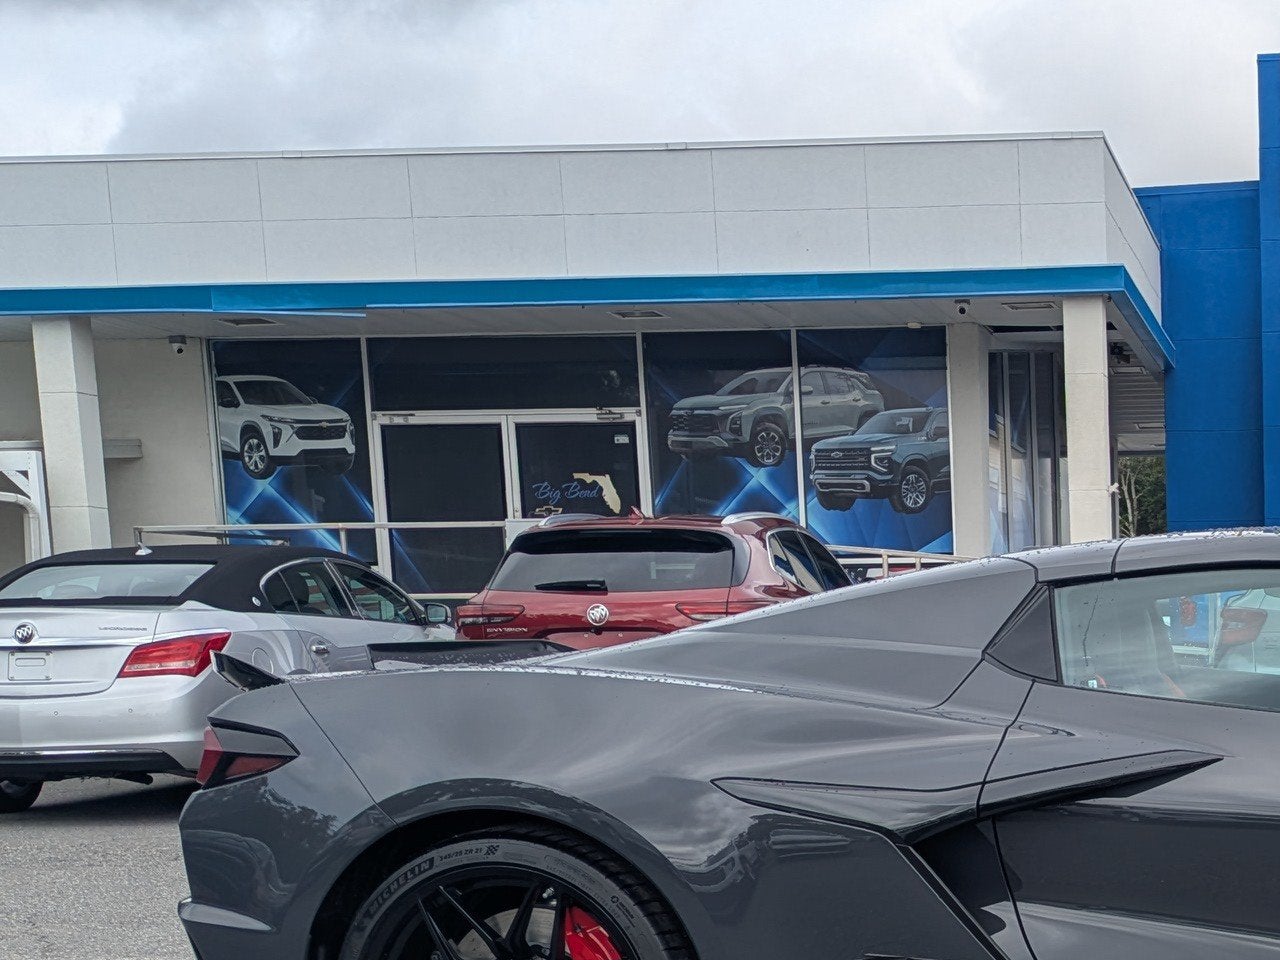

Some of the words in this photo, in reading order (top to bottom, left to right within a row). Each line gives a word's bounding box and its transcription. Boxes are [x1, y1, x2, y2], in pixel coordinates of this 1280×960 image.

[532, 481, 561, 504] Big
[562, 481, 599, 499] Bend
[369, 859, 430, 914] MICHELIN
